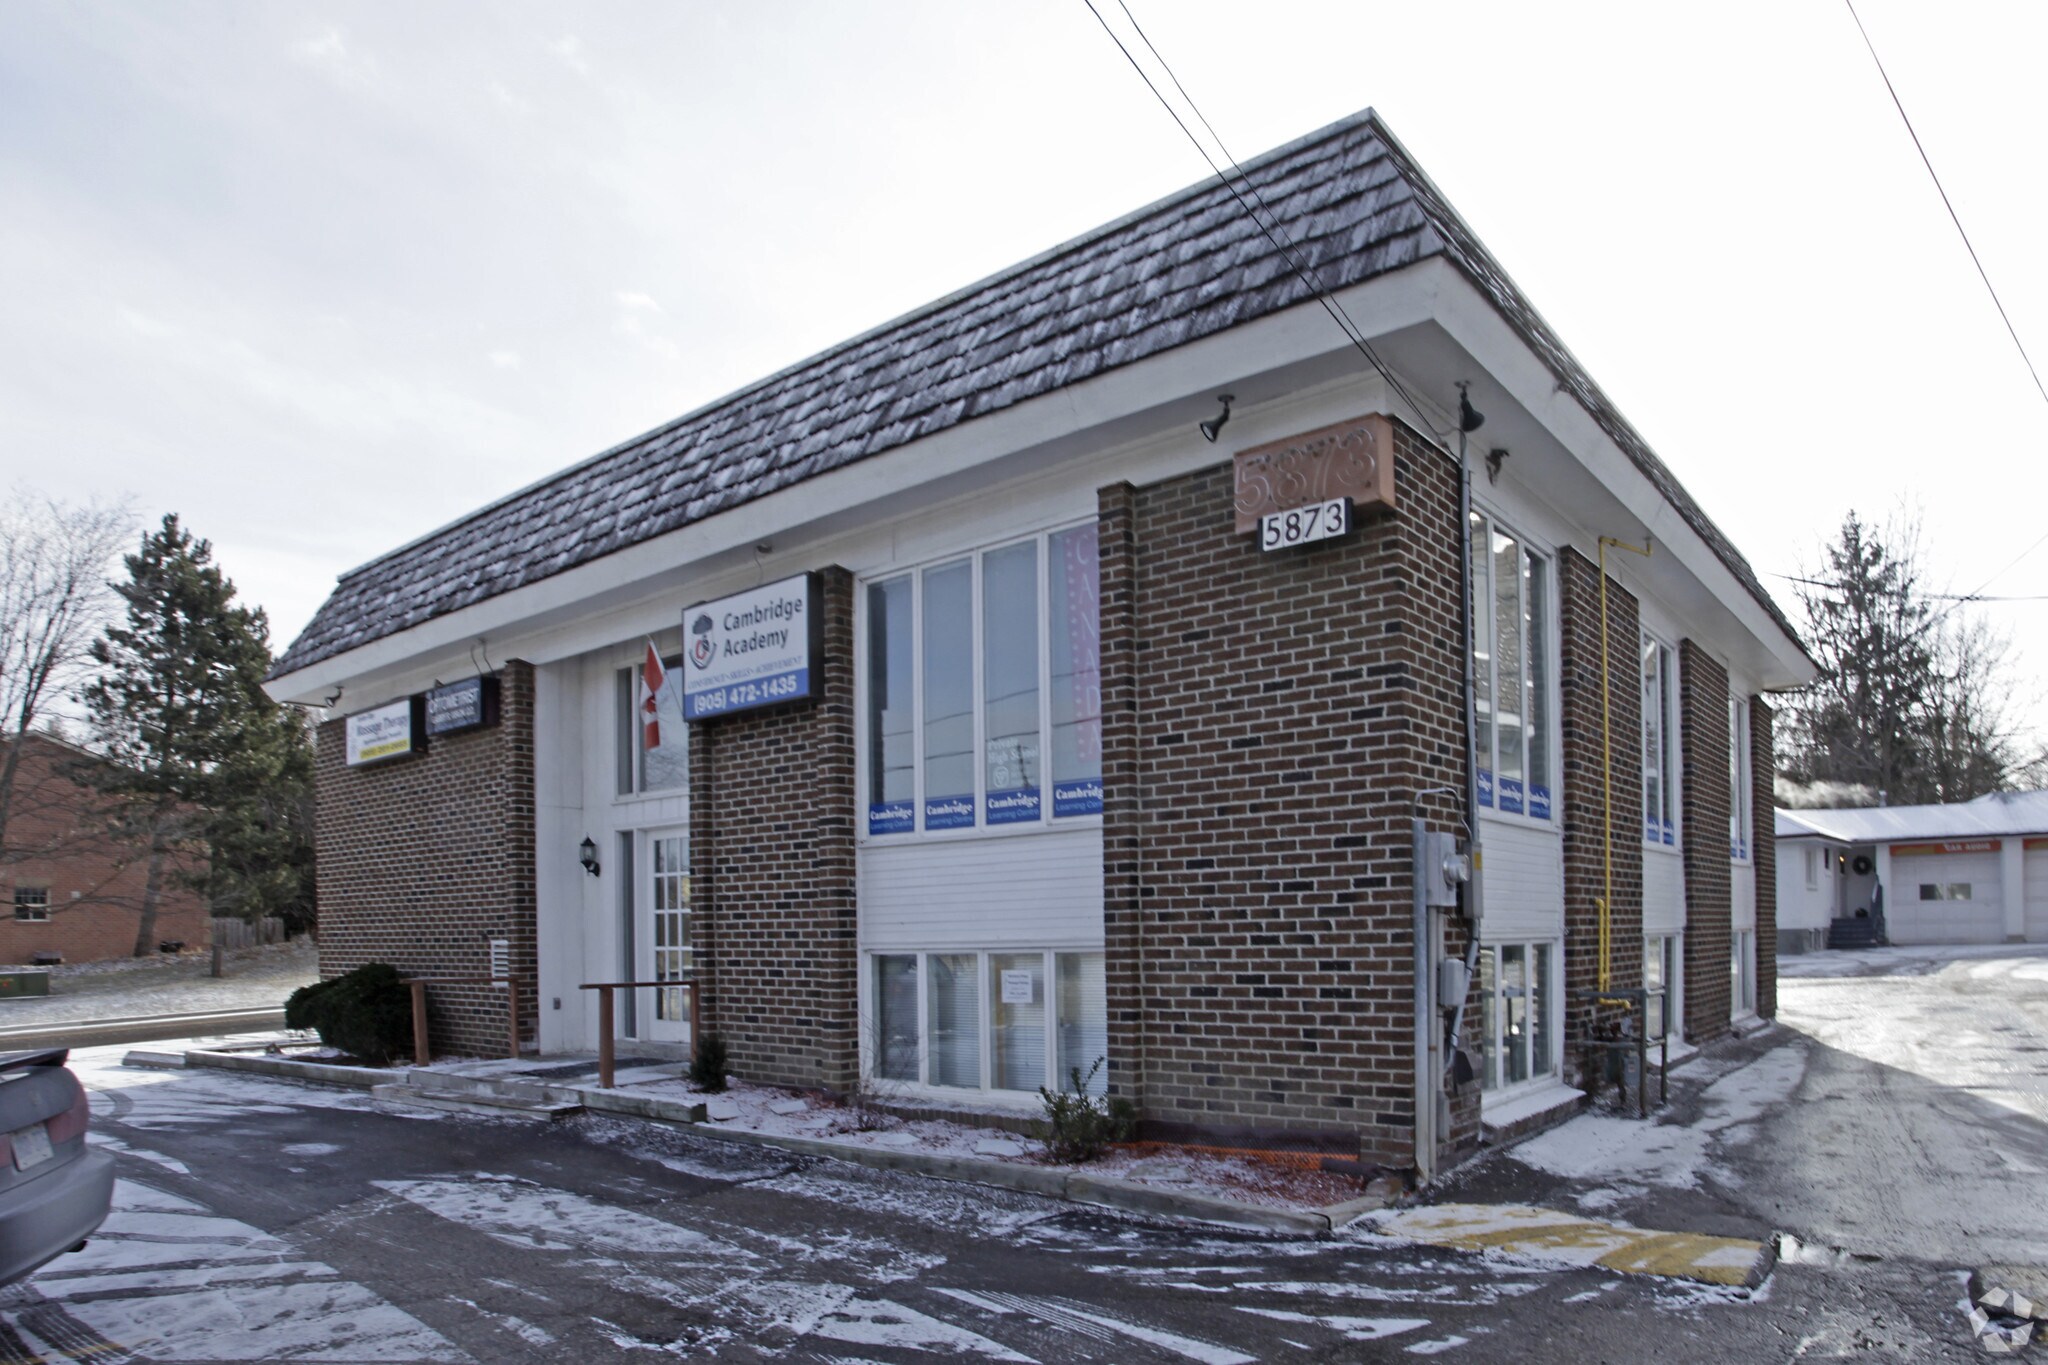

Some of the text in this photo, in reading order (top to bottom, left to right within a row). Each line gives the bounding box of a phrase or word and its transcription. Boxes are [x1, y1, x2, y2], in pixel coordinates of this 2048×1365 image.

[1234, 428, 1376, 516] 5873
[1265, 503, 1343, 546] 5873
[723, 597, 803, 632] Cambridge
[723, 629, 789, 658] Academy
[694, 674, 797, 715] (905) 472-1435
[988, 792, 1039, 809] Cambridge
[1055, 783, 1103, 800] Cambridg
[870, 805, 913, 820] Cambridge
[926, 800, 973, 815] Cambridge
